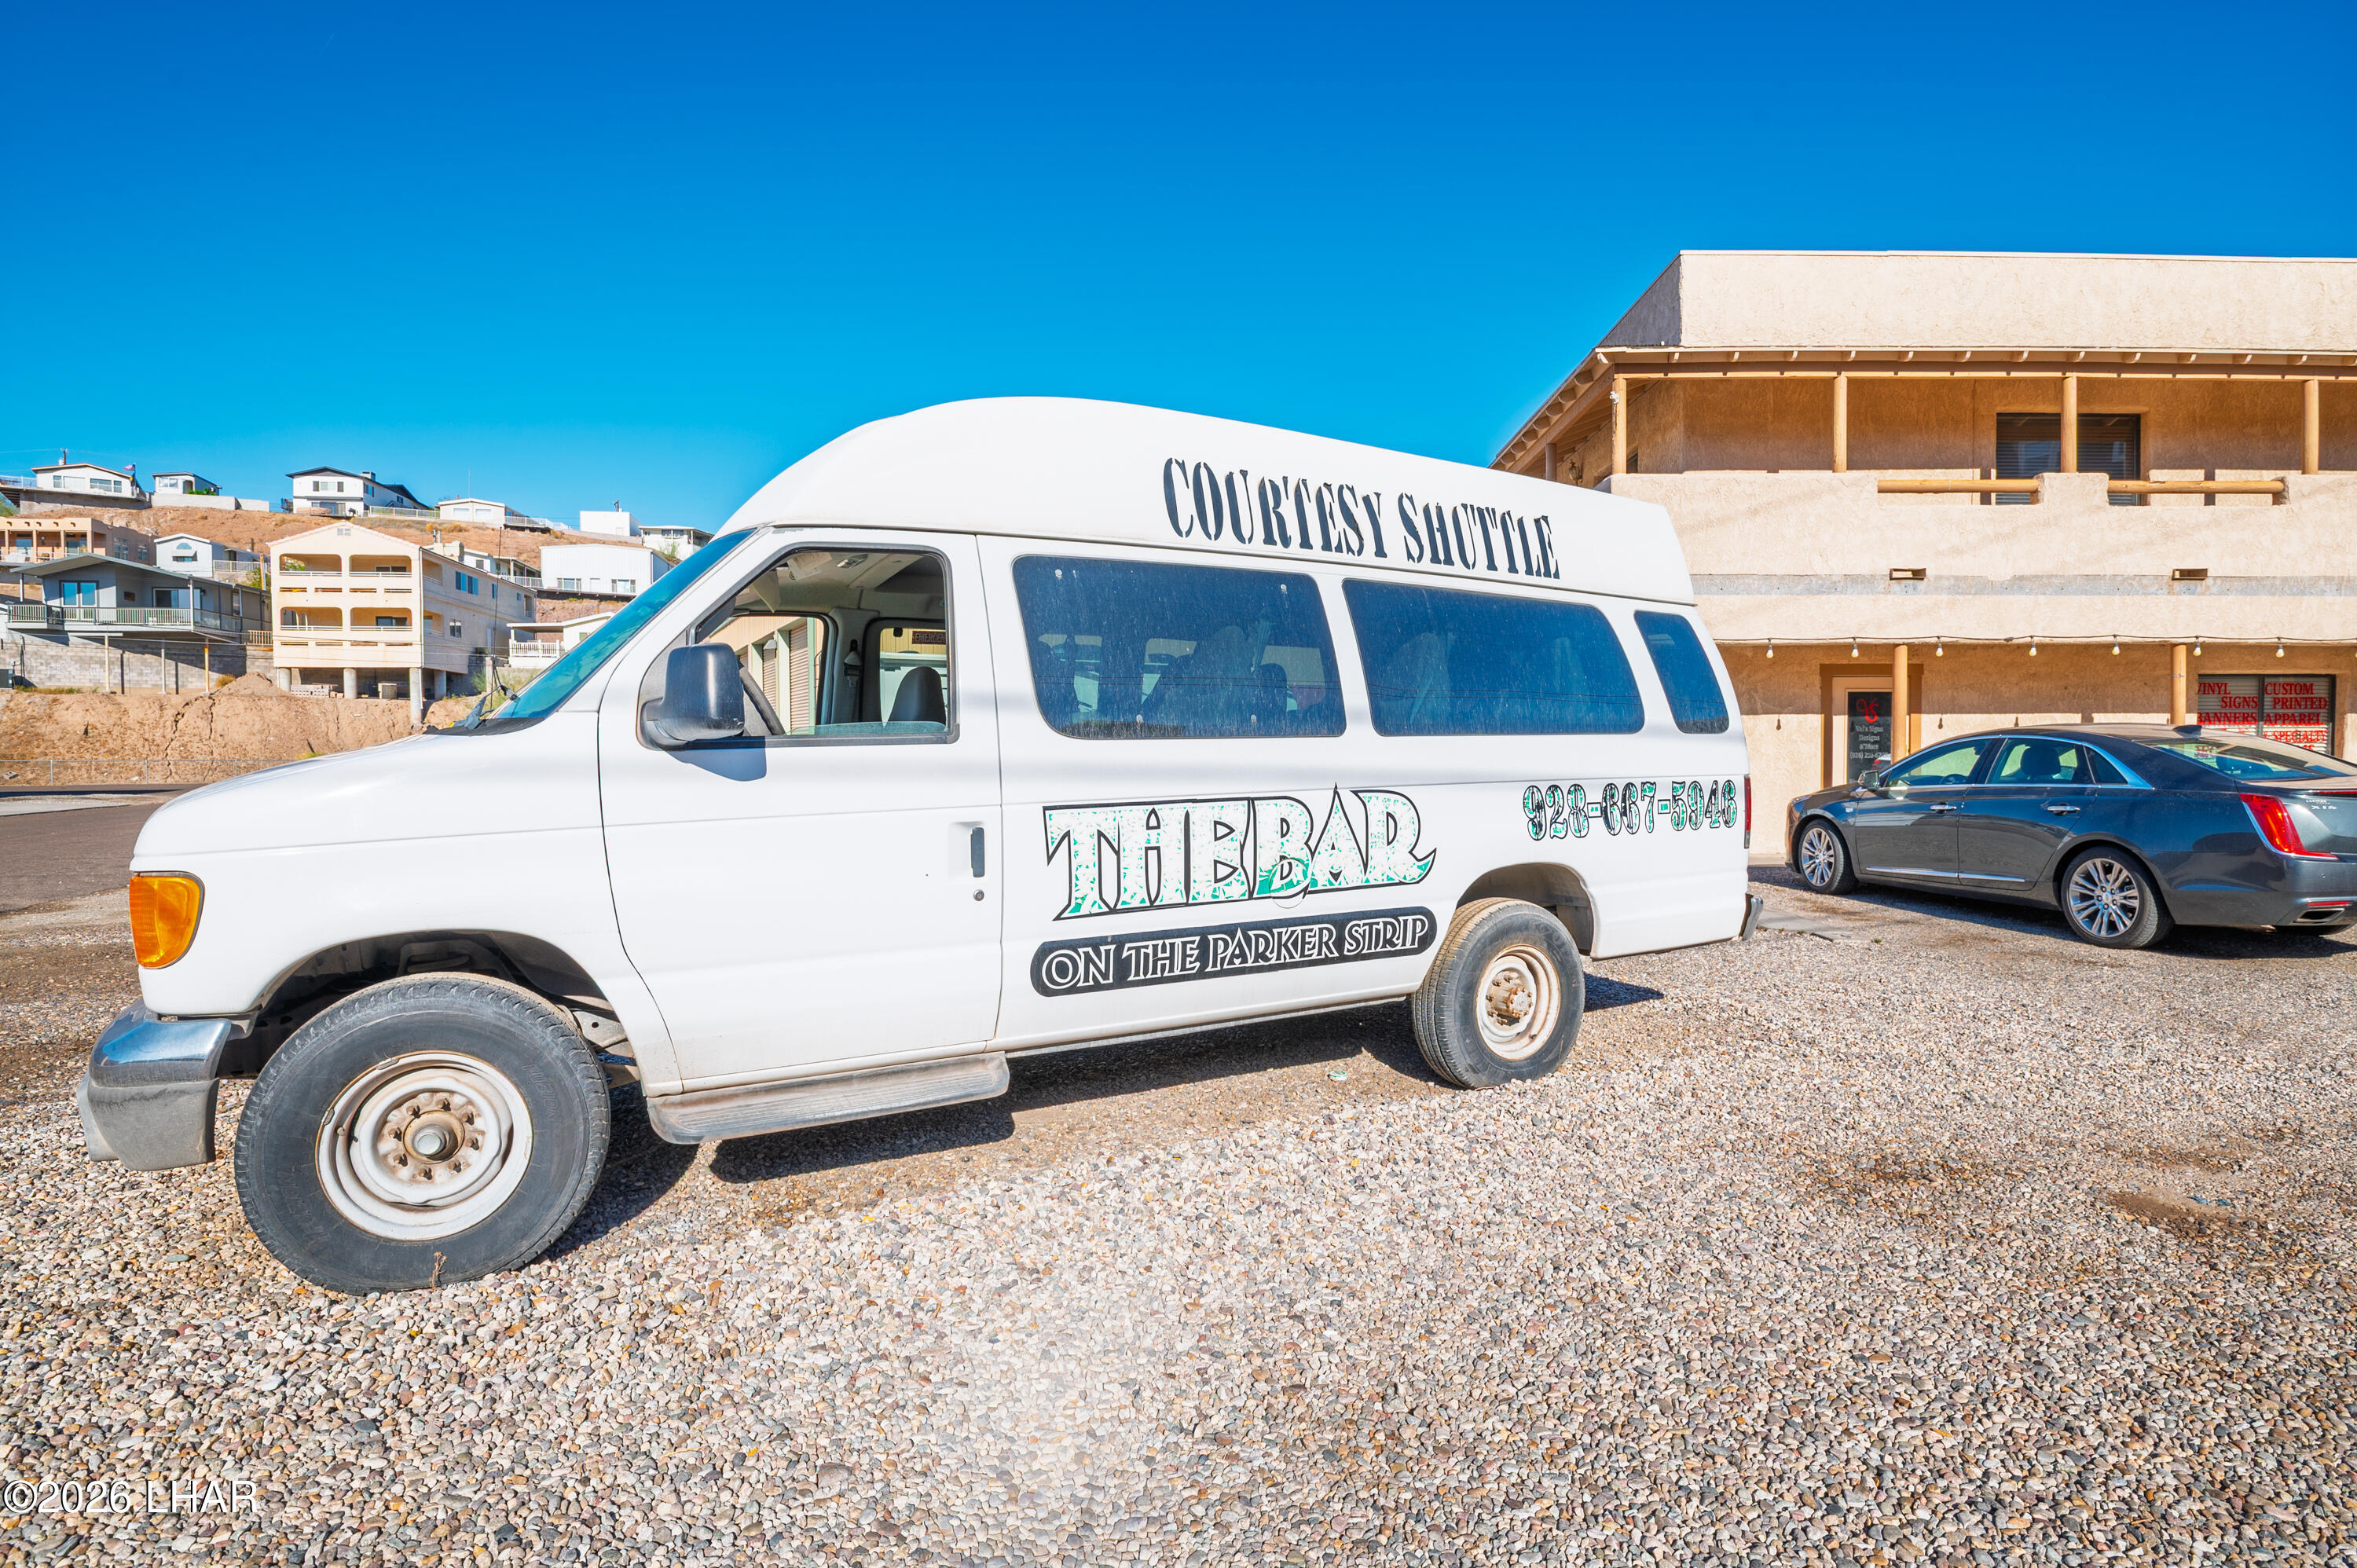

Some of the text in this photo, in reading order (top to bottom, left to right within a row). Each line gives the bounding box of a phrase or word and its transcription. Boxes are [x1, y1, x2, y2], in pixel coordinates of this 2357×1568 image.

[1163, 457, 1560, 580] COURTESY SHUTTLE
[2265, 682, 2314, 695] CUSTOM
[2220, 696, 2259, 709] SIGNS
[2273, 697, 2328, 709] PRINTED
[2263, 713, 2325, 726] APPAREL
[1869, 724, 1884, 734] Signs
[1859, 734, 1880, 742] Designs
[1523, 779, 1738, 841] 928-667-5946
[1041, 914, 1429, 990] ON THE PARKER STRIP
